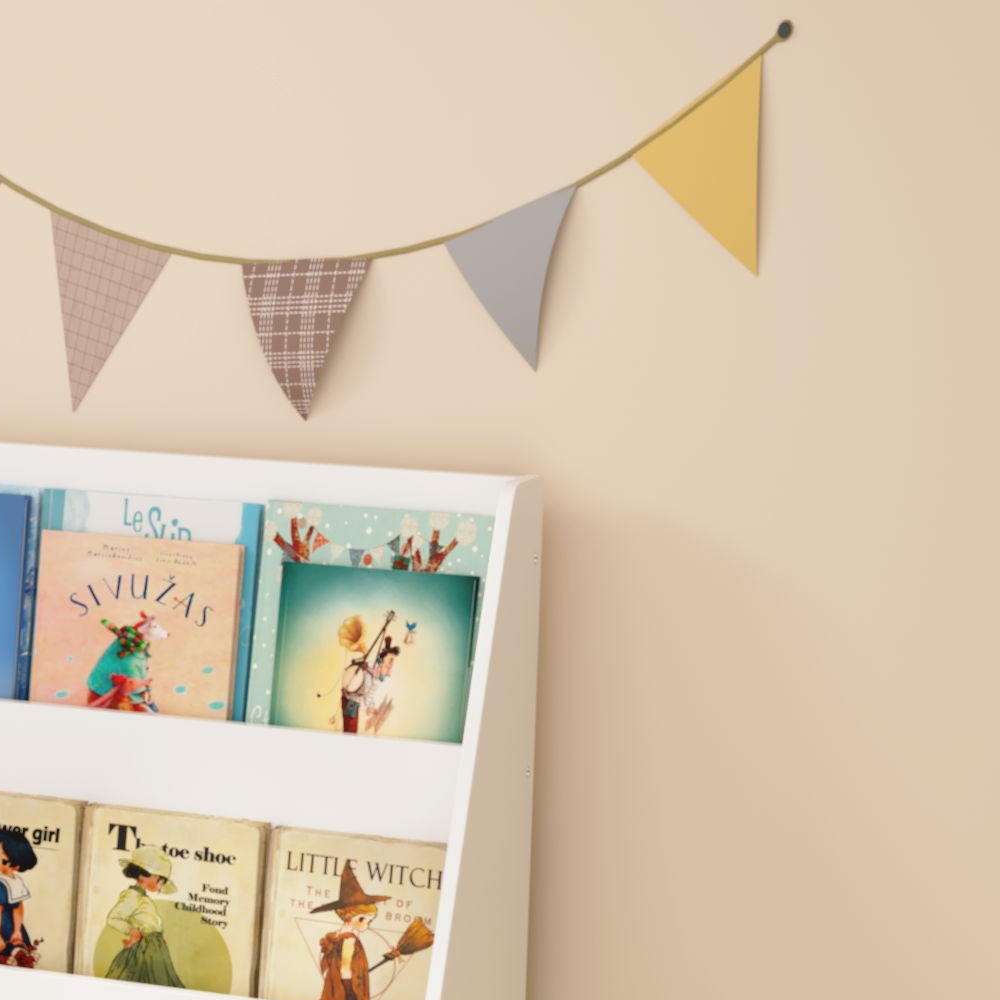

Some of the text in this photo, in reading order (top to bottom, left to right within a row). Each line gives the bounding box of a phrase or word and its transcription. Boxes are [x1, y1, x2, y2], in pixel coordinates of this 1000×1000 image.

[123, 498, 143, 533] Le
[69, 573, 213, 628] SIVUŽAS
[32, 826, 60, 846] girl
[194, 846, 236, 865] shoe
[366, 861, 443, 890] WITCH
[202, 883, 228, 895] Fond
[306, 886, 413, 909] THE OF
[174, 902, 227, 916] Childhood
[188, 893, 230, 906] Memory
[290, 898, 432, 925] THE BROM
[200, 916, 228, 929] Story
